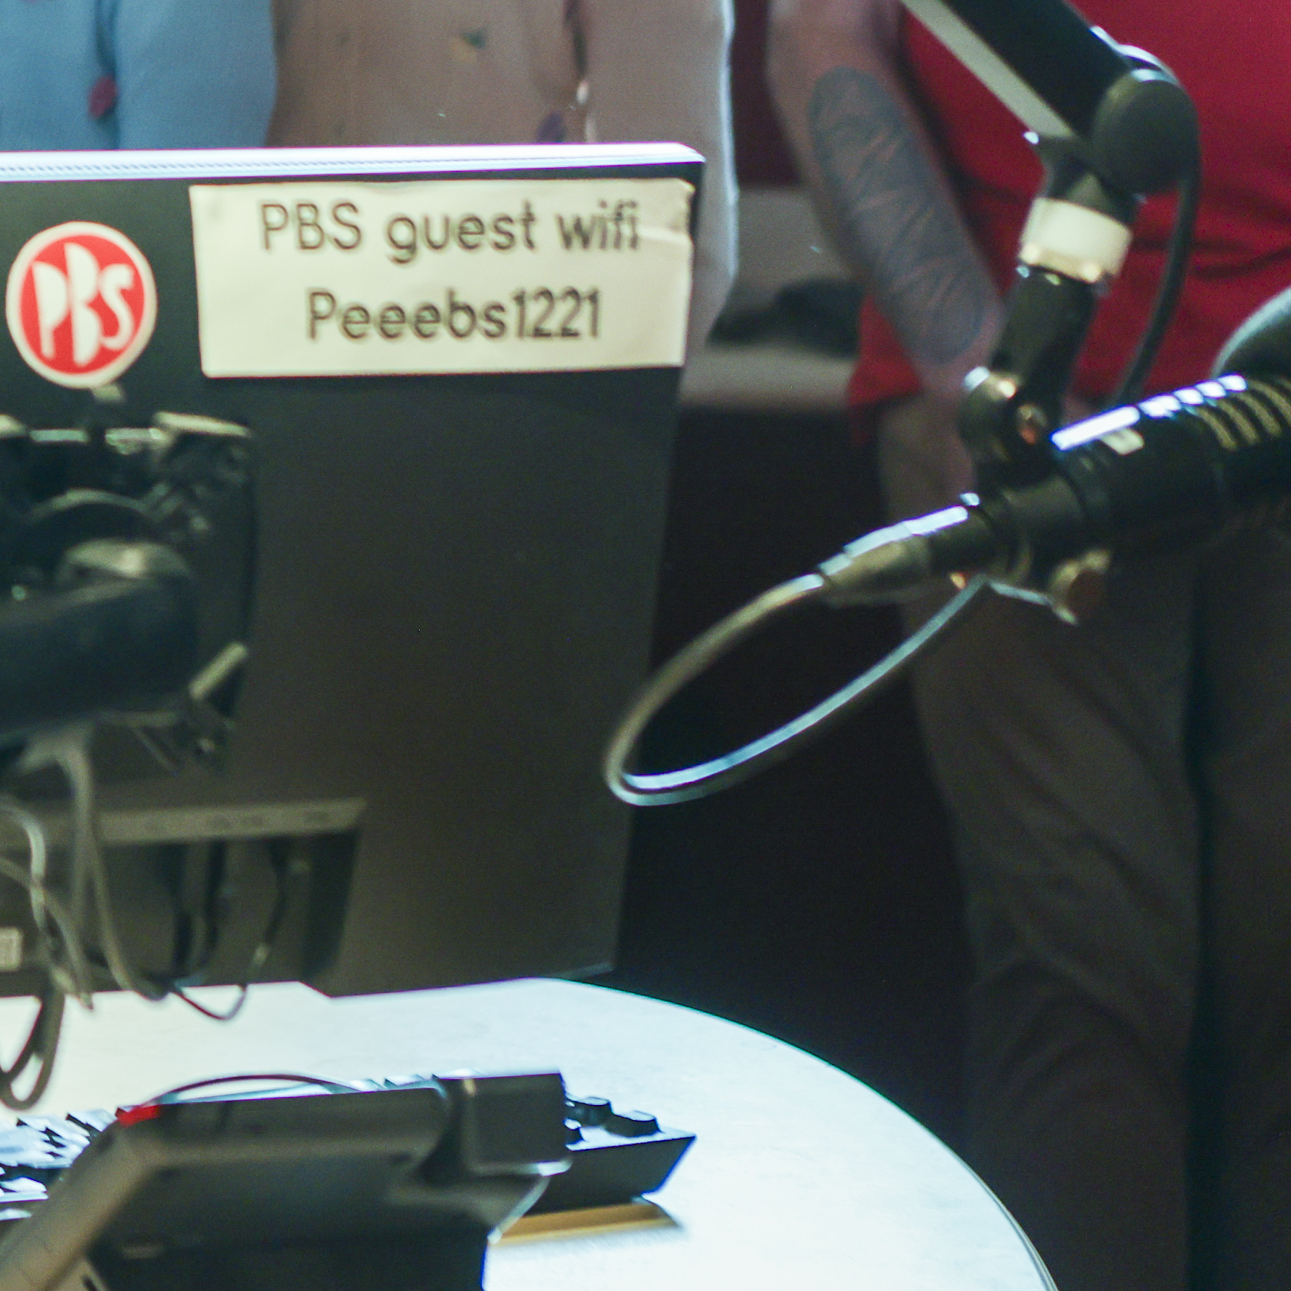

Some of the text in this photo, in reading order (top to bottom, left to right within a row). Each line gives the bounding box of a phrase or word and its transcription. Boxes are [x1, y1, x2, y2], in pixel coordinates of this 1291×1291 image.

[260, 198, 638, 265] PBS guest wifi
[30, 241, 134, 368] PBS
[308, 286, 600, 340] Peeebs1221
